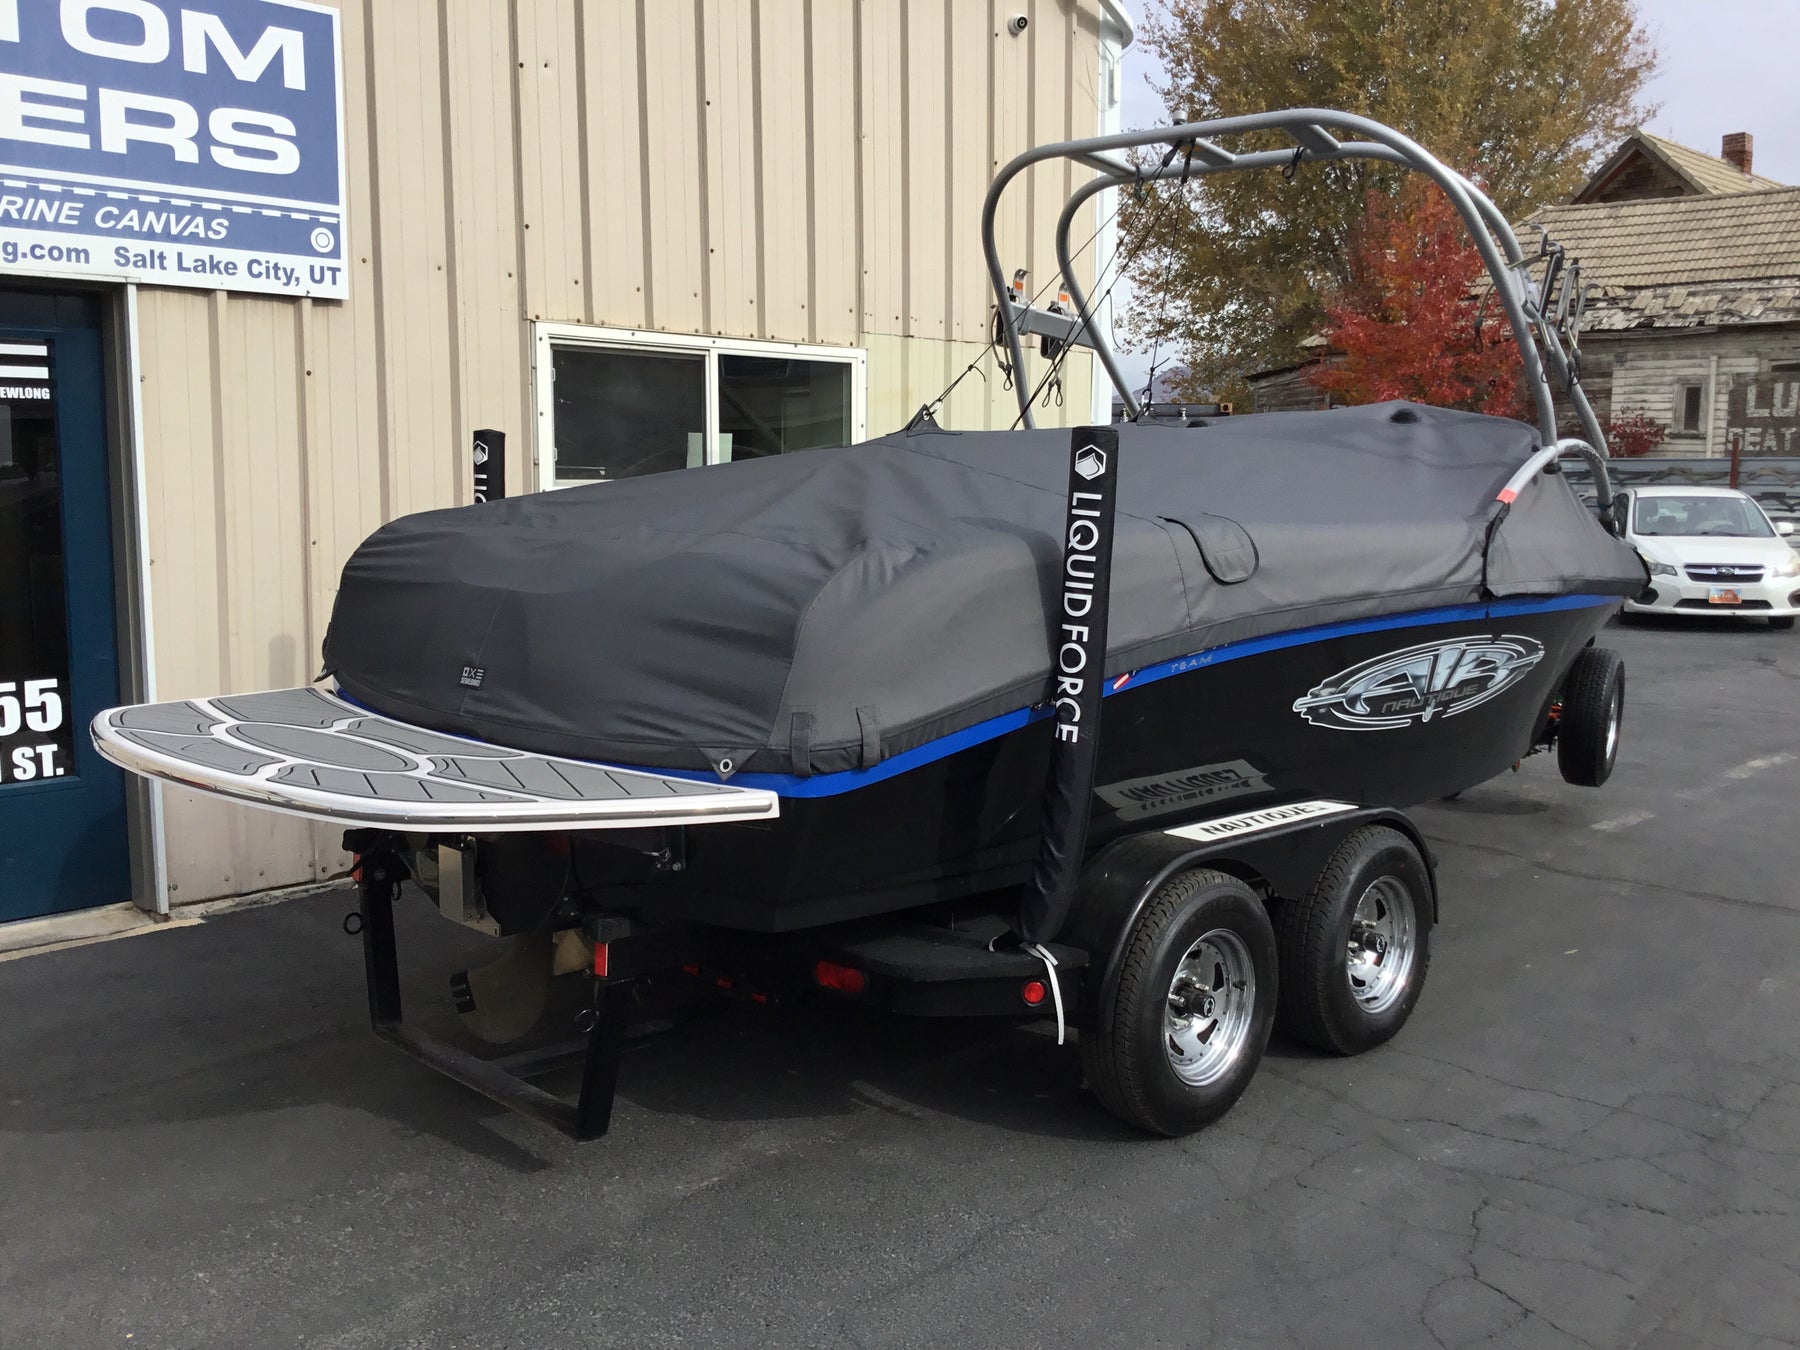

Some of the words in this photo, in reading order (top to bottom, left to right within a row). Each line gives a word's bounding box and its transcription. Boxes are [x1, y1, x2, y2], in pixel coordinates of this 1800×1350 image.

[0, 73, 300, 175] ERS
[0, 195, 84, 225] RINE
[95, 206, 229, 240] CANVAS
[114, 246, 167, 271] Salt
[177, 252, 238, 276] Lake
[247, 258, 300, 287] City,
[309, 264, 341, 286] UT
[1063, 492, 1103, 618] LIQUID
[1055, 623, 1089, 743] FORCE
[1170, 655, 1213, 672] TEAM
[12, 743, 64, 781] ST.
